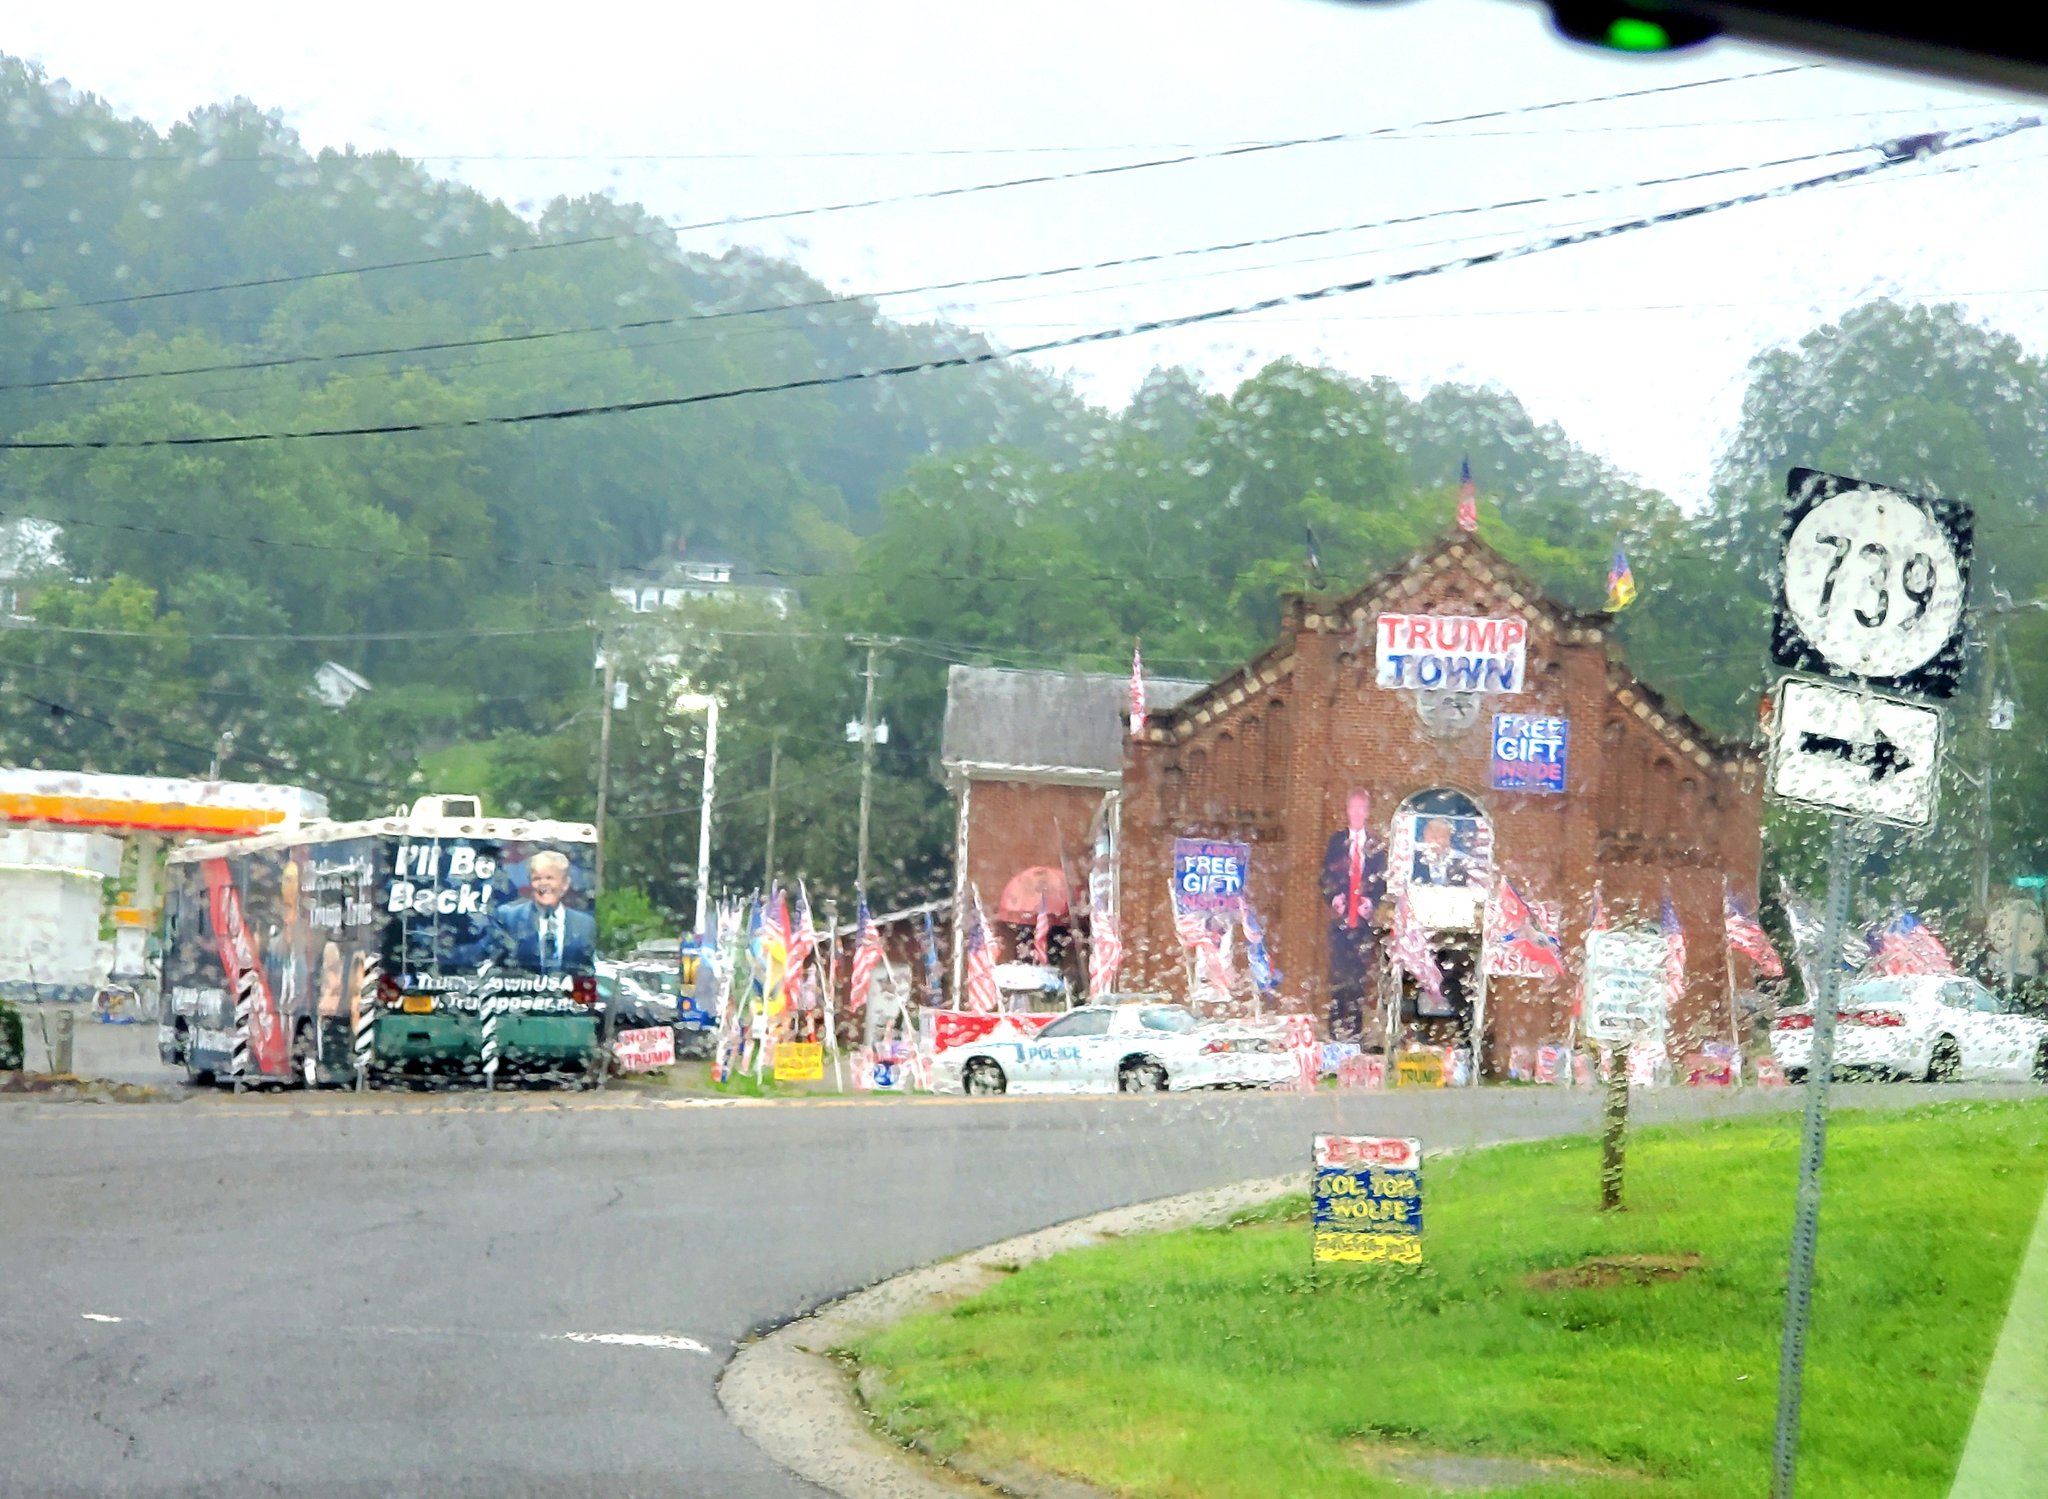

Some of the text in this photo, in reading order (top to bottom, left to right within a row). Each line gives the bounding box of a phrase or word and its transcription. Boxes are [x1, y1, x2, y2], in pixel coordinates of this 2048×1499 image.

[1816, 531, 1936, 631] 739
[1379, 617, 1524, 653] TRUMP
[1389, 654, 1514, 690] TOWN
[1498, 716, 1563, 739] FREE
[1496, 737, 1564, 762] GIFT
[394, 845, 440, 876] I'll
[449, 846, 496, 879] Be
[1183, 855, 1239, 876] FREE
[387, 881, 492, 915] Back!
[1182, 873, 1240, 897] GIFT
[1029, 1046, 1082, 1060] POLICE
